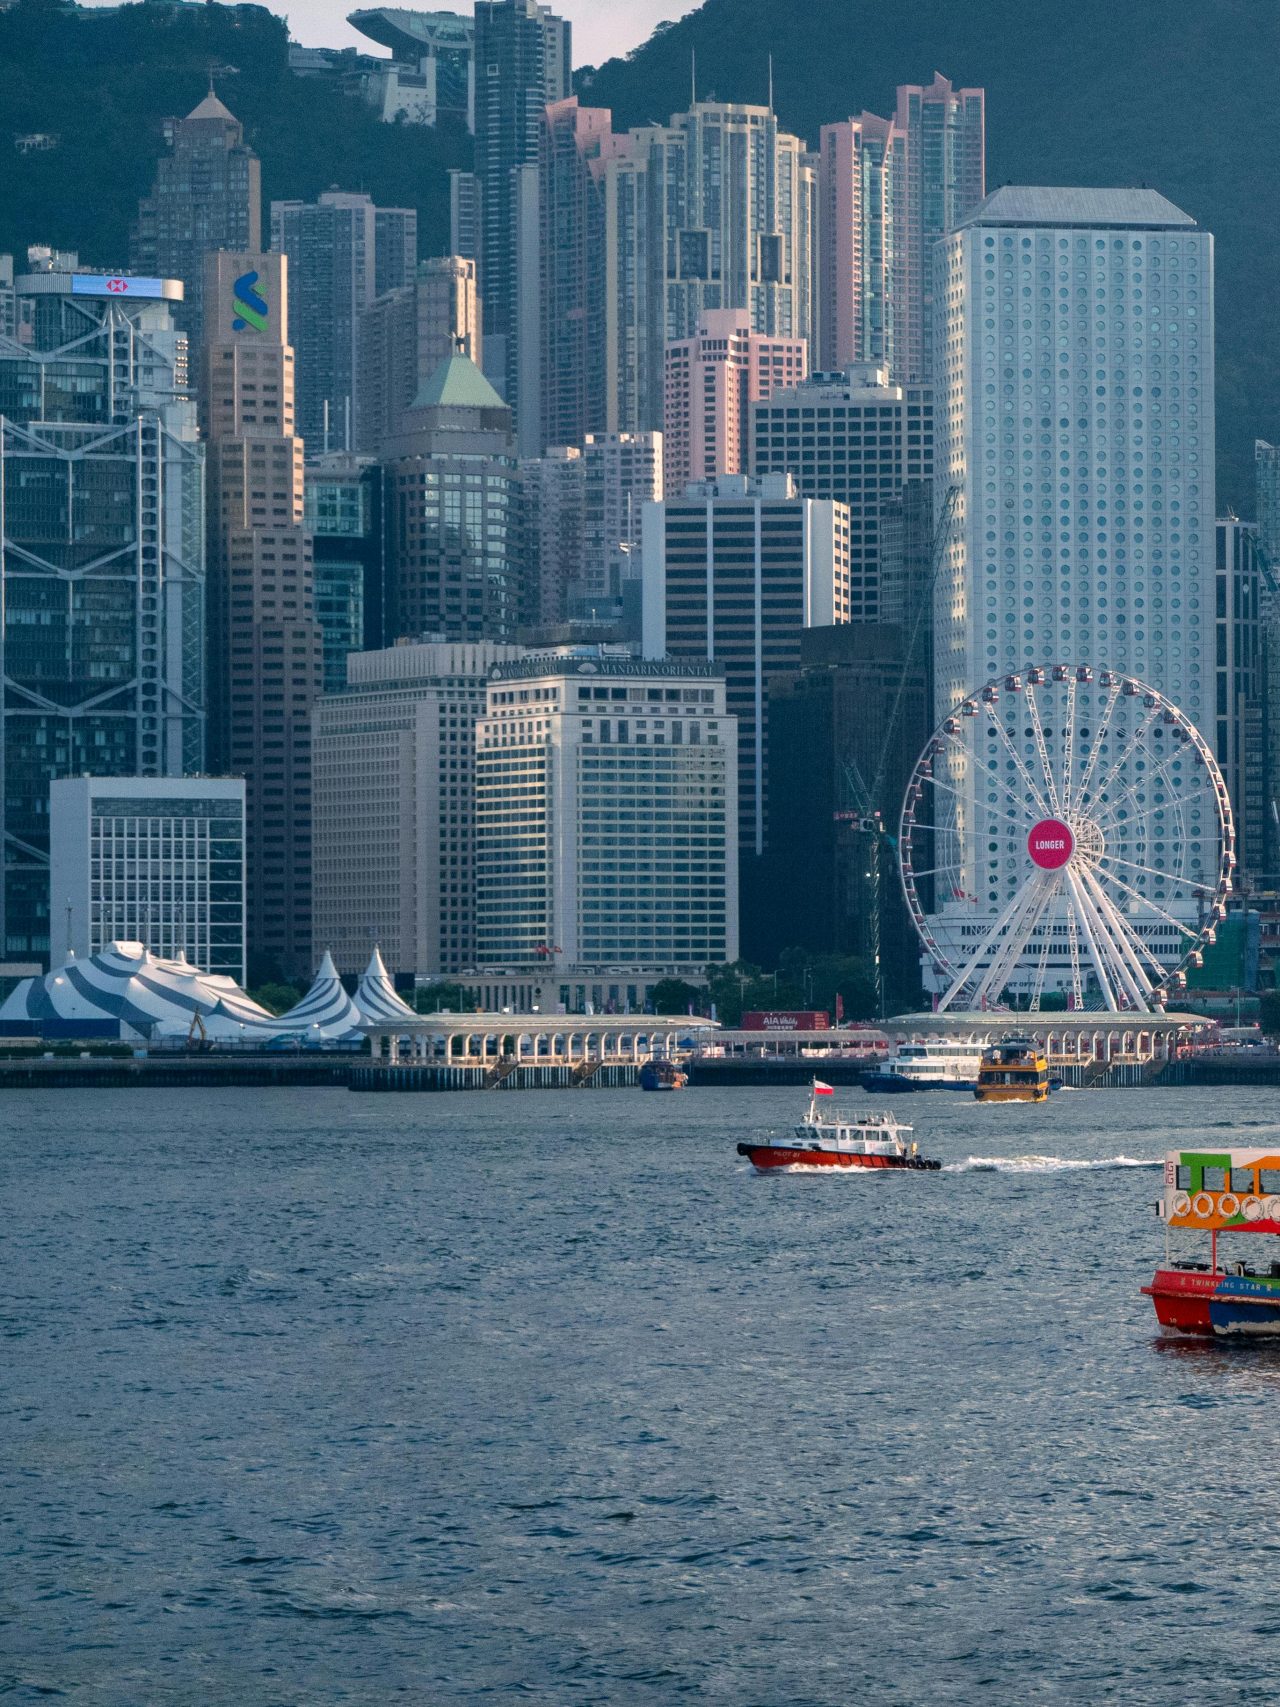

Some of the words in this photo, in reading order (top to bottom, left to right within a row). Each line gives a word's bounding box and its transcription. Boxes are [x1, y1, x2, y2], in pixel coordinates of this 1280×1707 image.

[601, 665, 659, 674] MANDARIN
[661, 666, 713, 676] ORIENTAL
[1035, 840, 1065, 850] LONGER
[763, 1017, 779, 1025] AIA
[1192, 1279, 1235, 1289] TWINKLING
[1240, 1283, 1261, 1291] STAR
